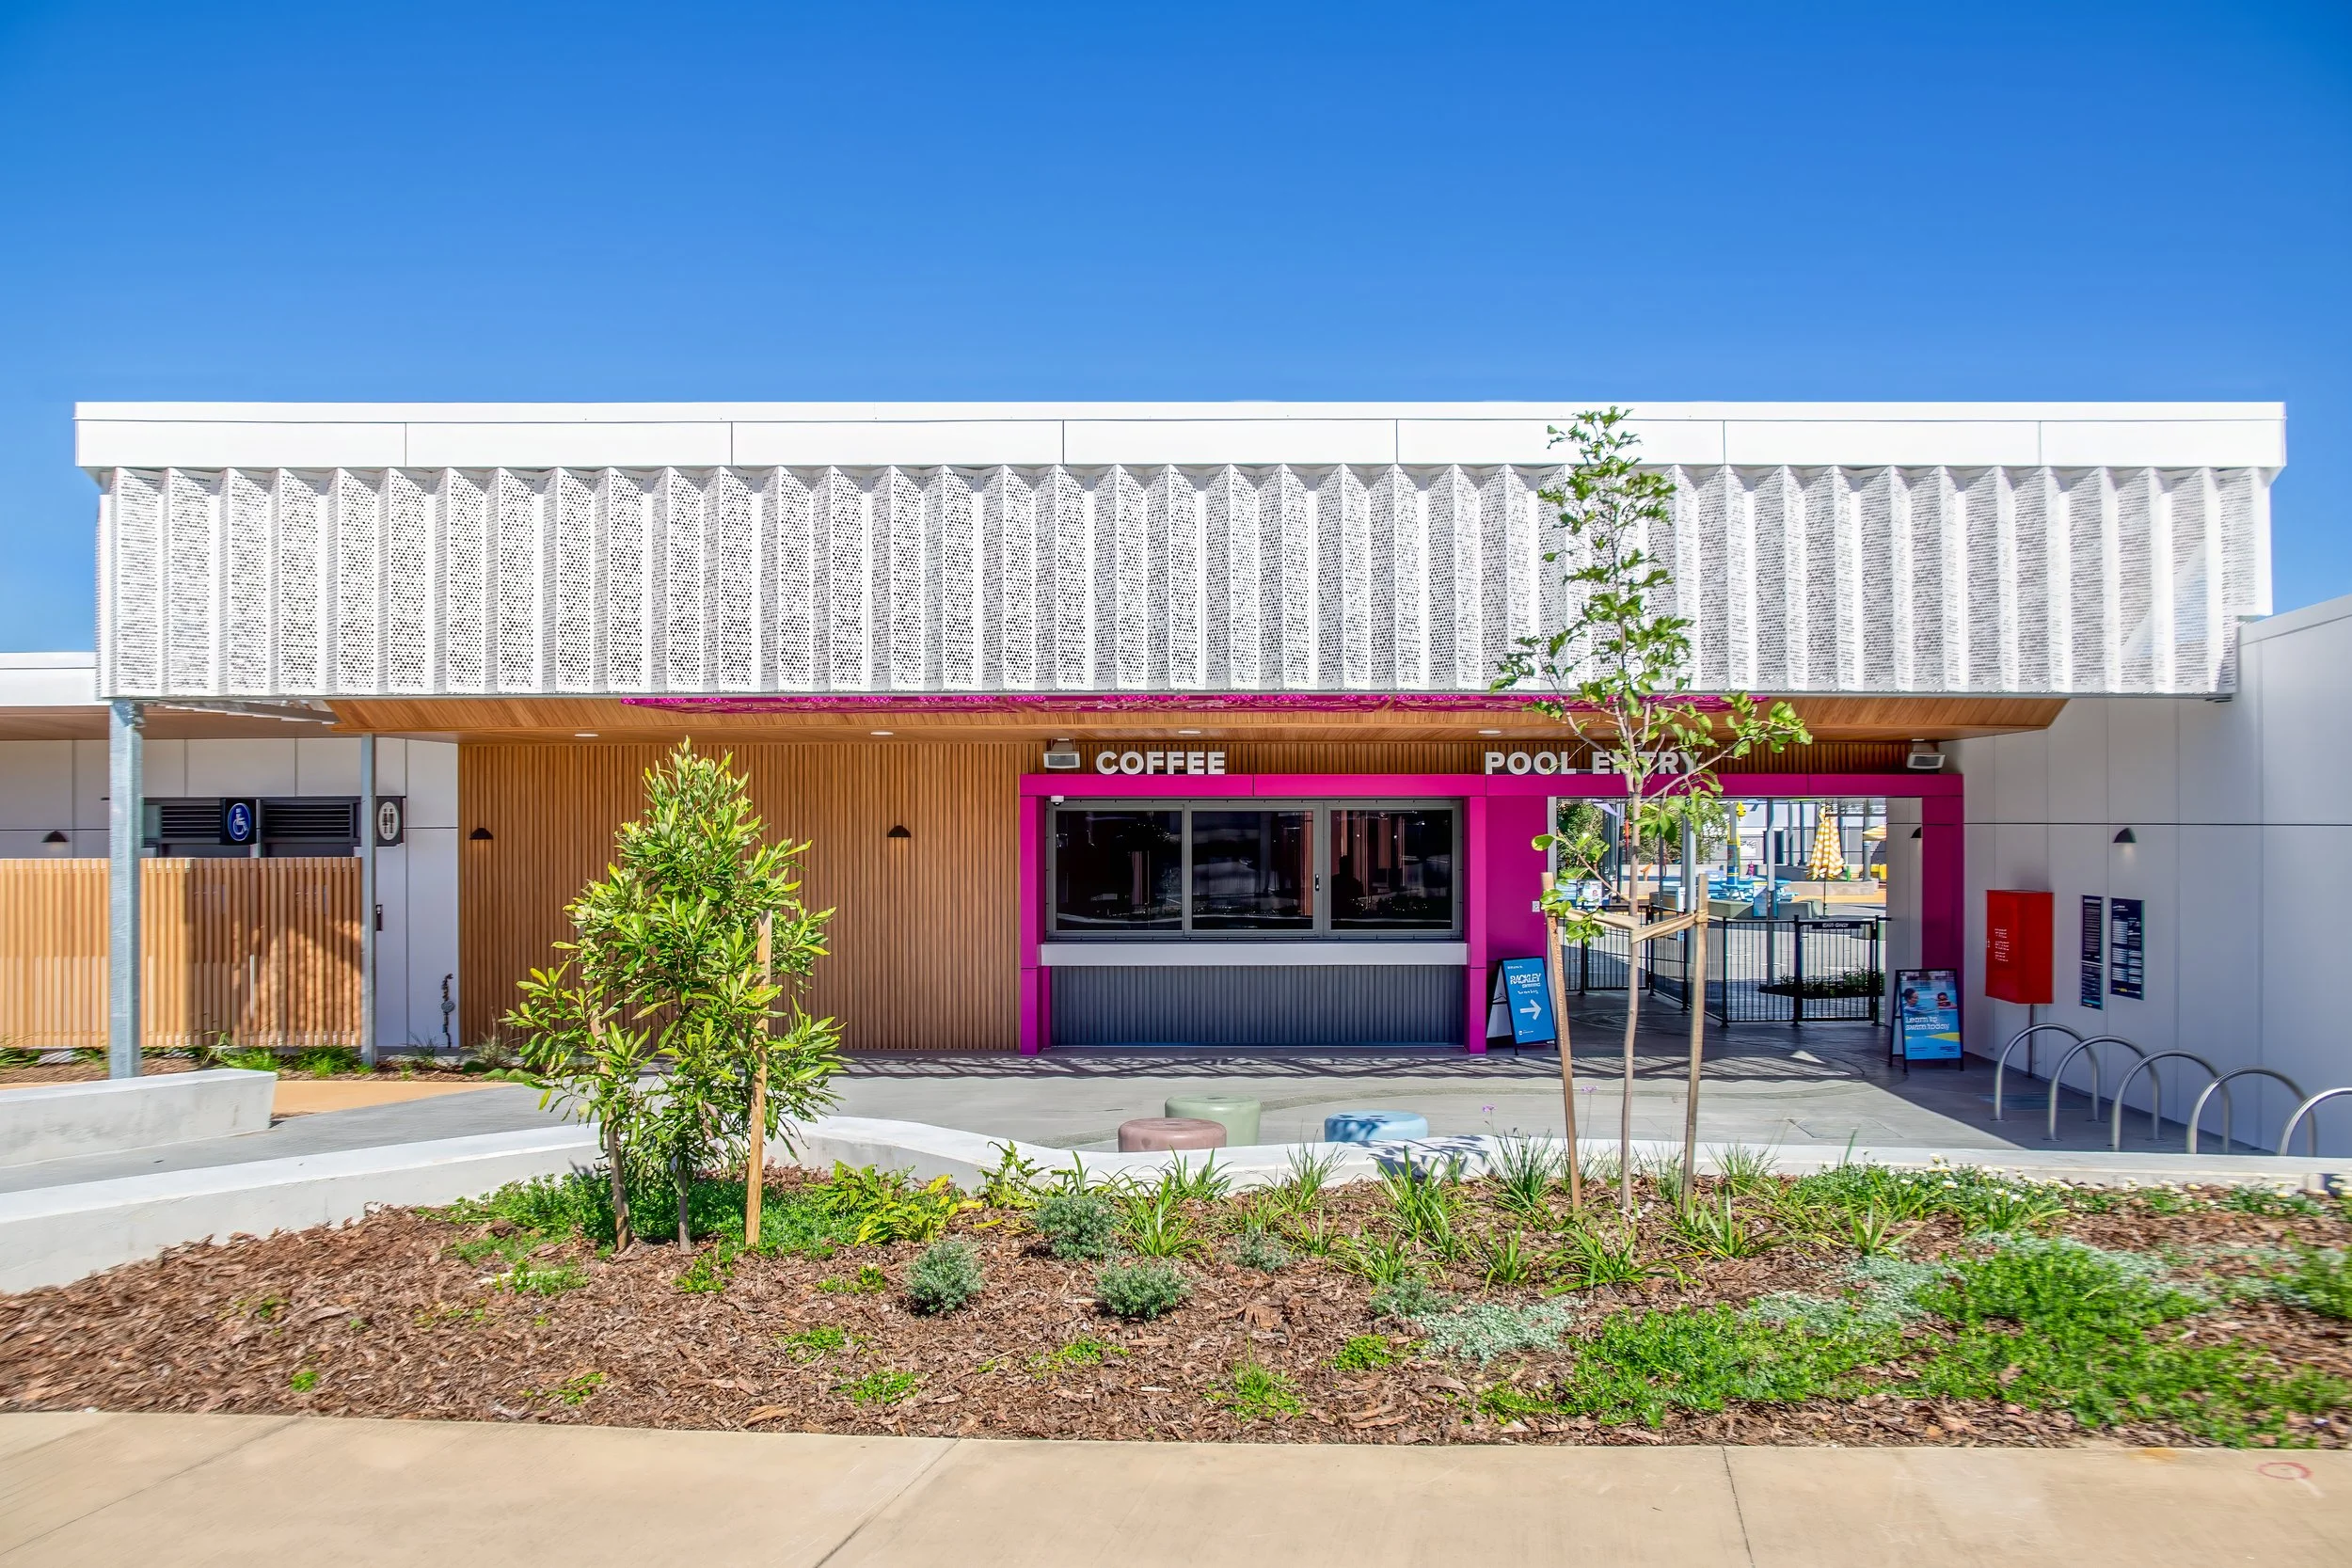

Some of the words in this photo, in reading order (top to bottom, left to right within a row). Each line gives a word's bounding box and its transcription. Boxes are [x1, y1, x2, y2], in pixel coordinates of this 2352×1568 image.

[1096, 751, 1225, 775] COFFEE
[1485, 752, 1577, 775] POOL
[1510, 974, 1541, 984] RACKLEY
